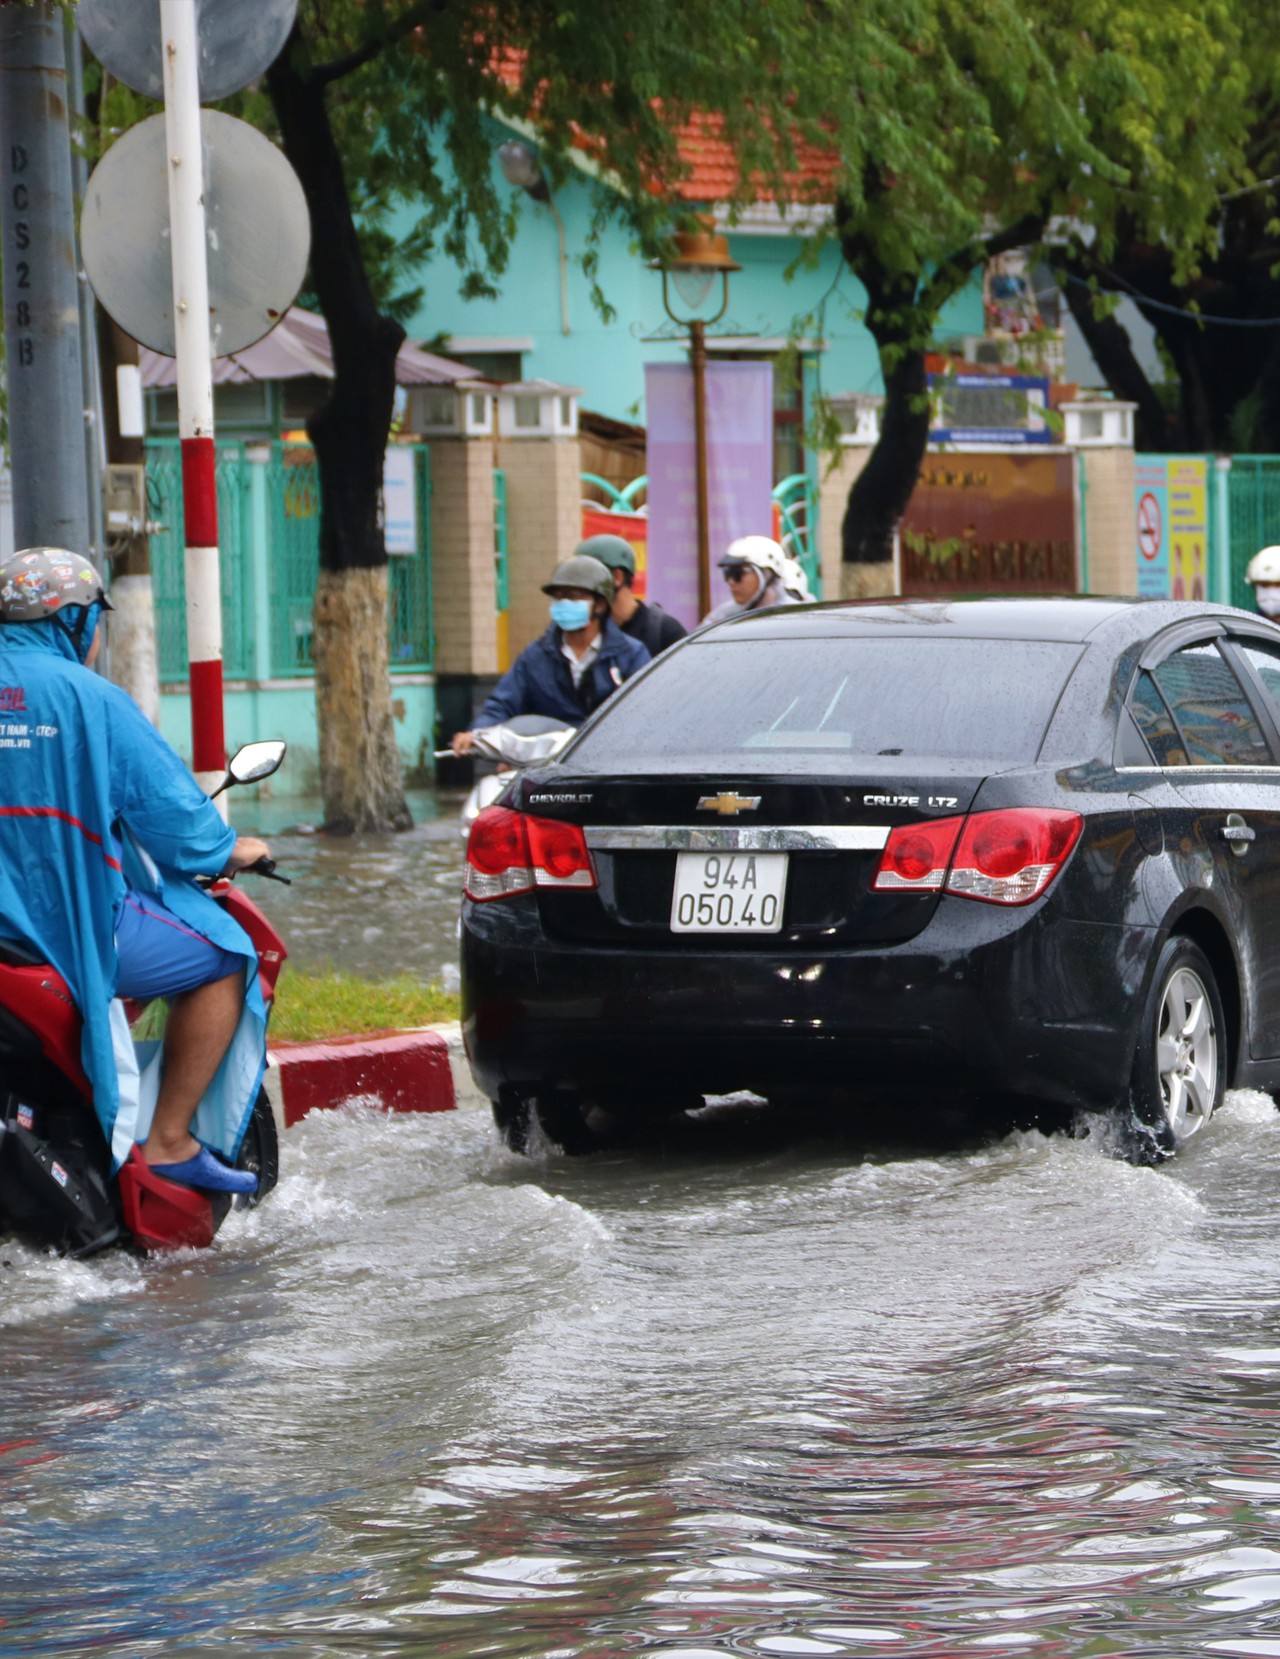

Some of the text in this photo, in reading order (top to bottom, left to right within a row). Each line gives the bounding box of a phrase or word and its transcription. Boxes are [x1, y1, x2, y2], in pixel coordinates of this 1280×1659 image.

[529, 794, 593, 804] CHEVROLET
[863, 795, 958, 808] CRUZE LTZ
[703, 855, 757, 890] 94A
[678, 893, 778, 927] 050.40
